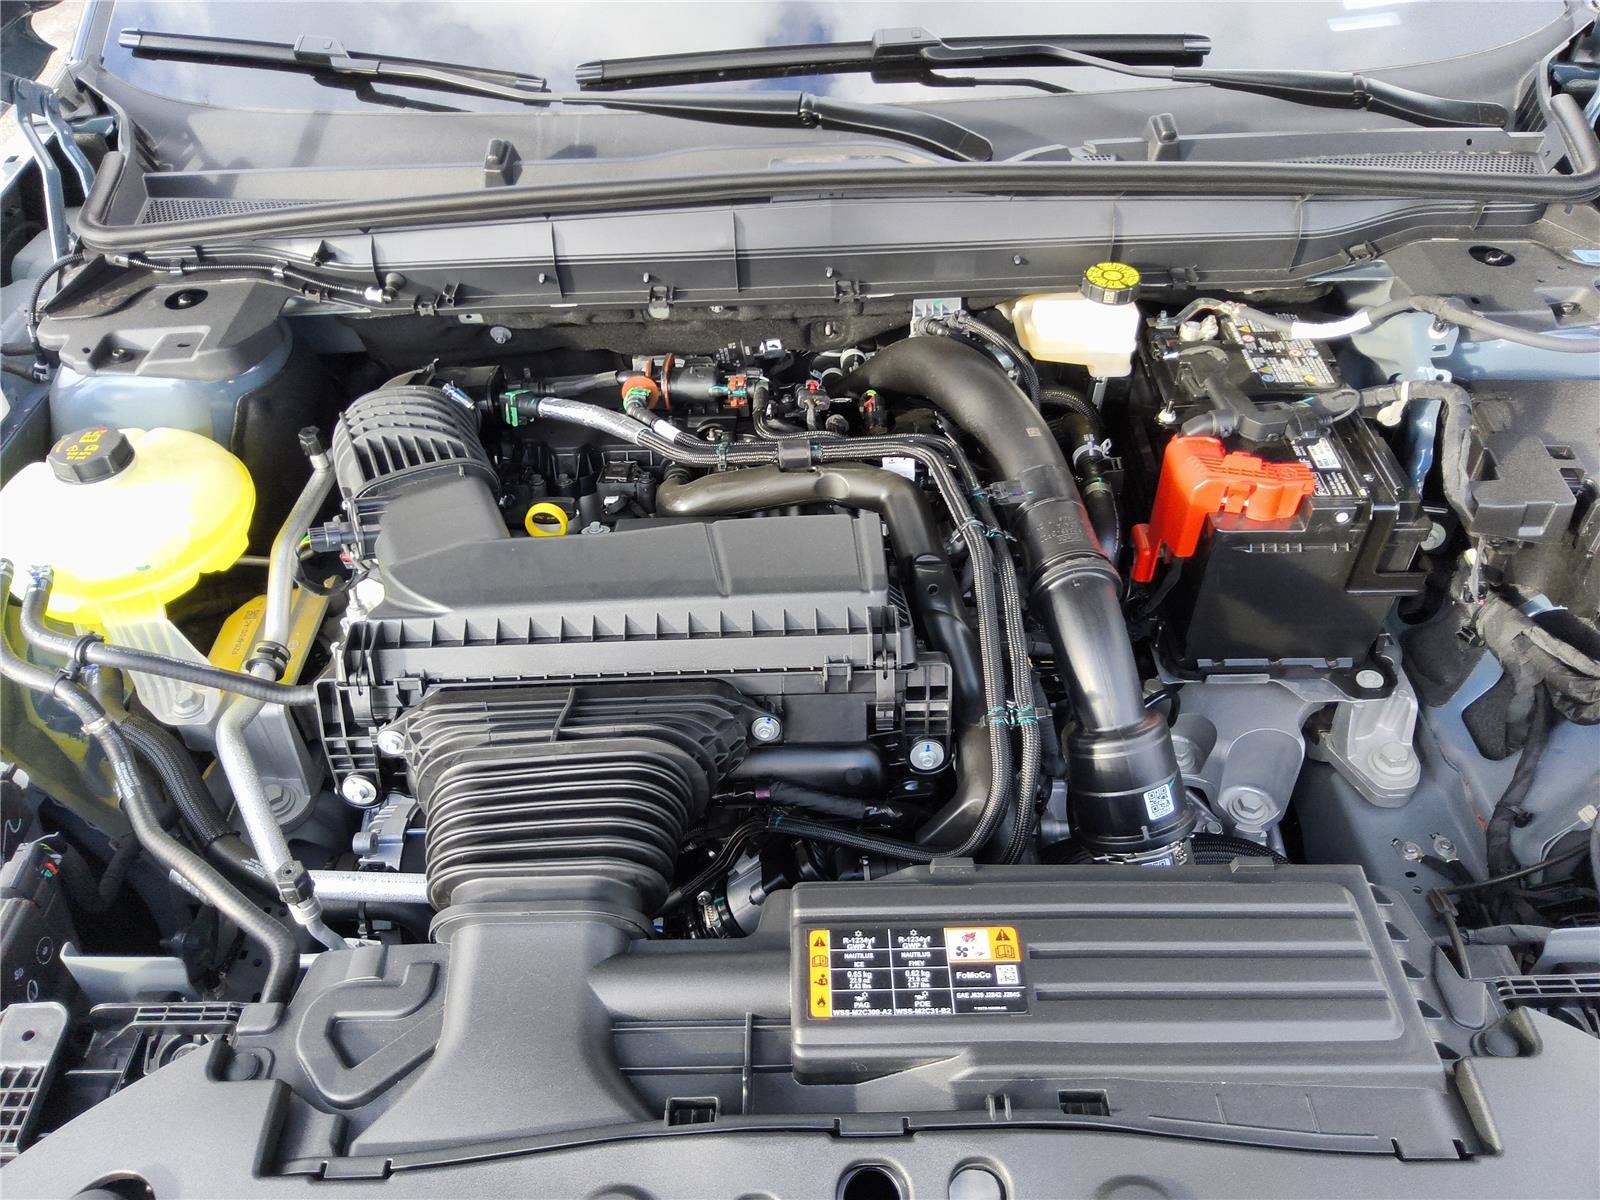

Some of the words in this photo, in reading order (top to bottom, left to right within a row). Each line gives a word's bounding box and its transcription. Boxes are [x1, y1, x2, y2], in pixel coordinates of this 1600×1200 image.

[842, 936, 876, 945] R-1234yf
[898, 936, 931, 944] R-1234yf
[862, 970, 872, 979] kg
[920, 970, 930, 978] kg
